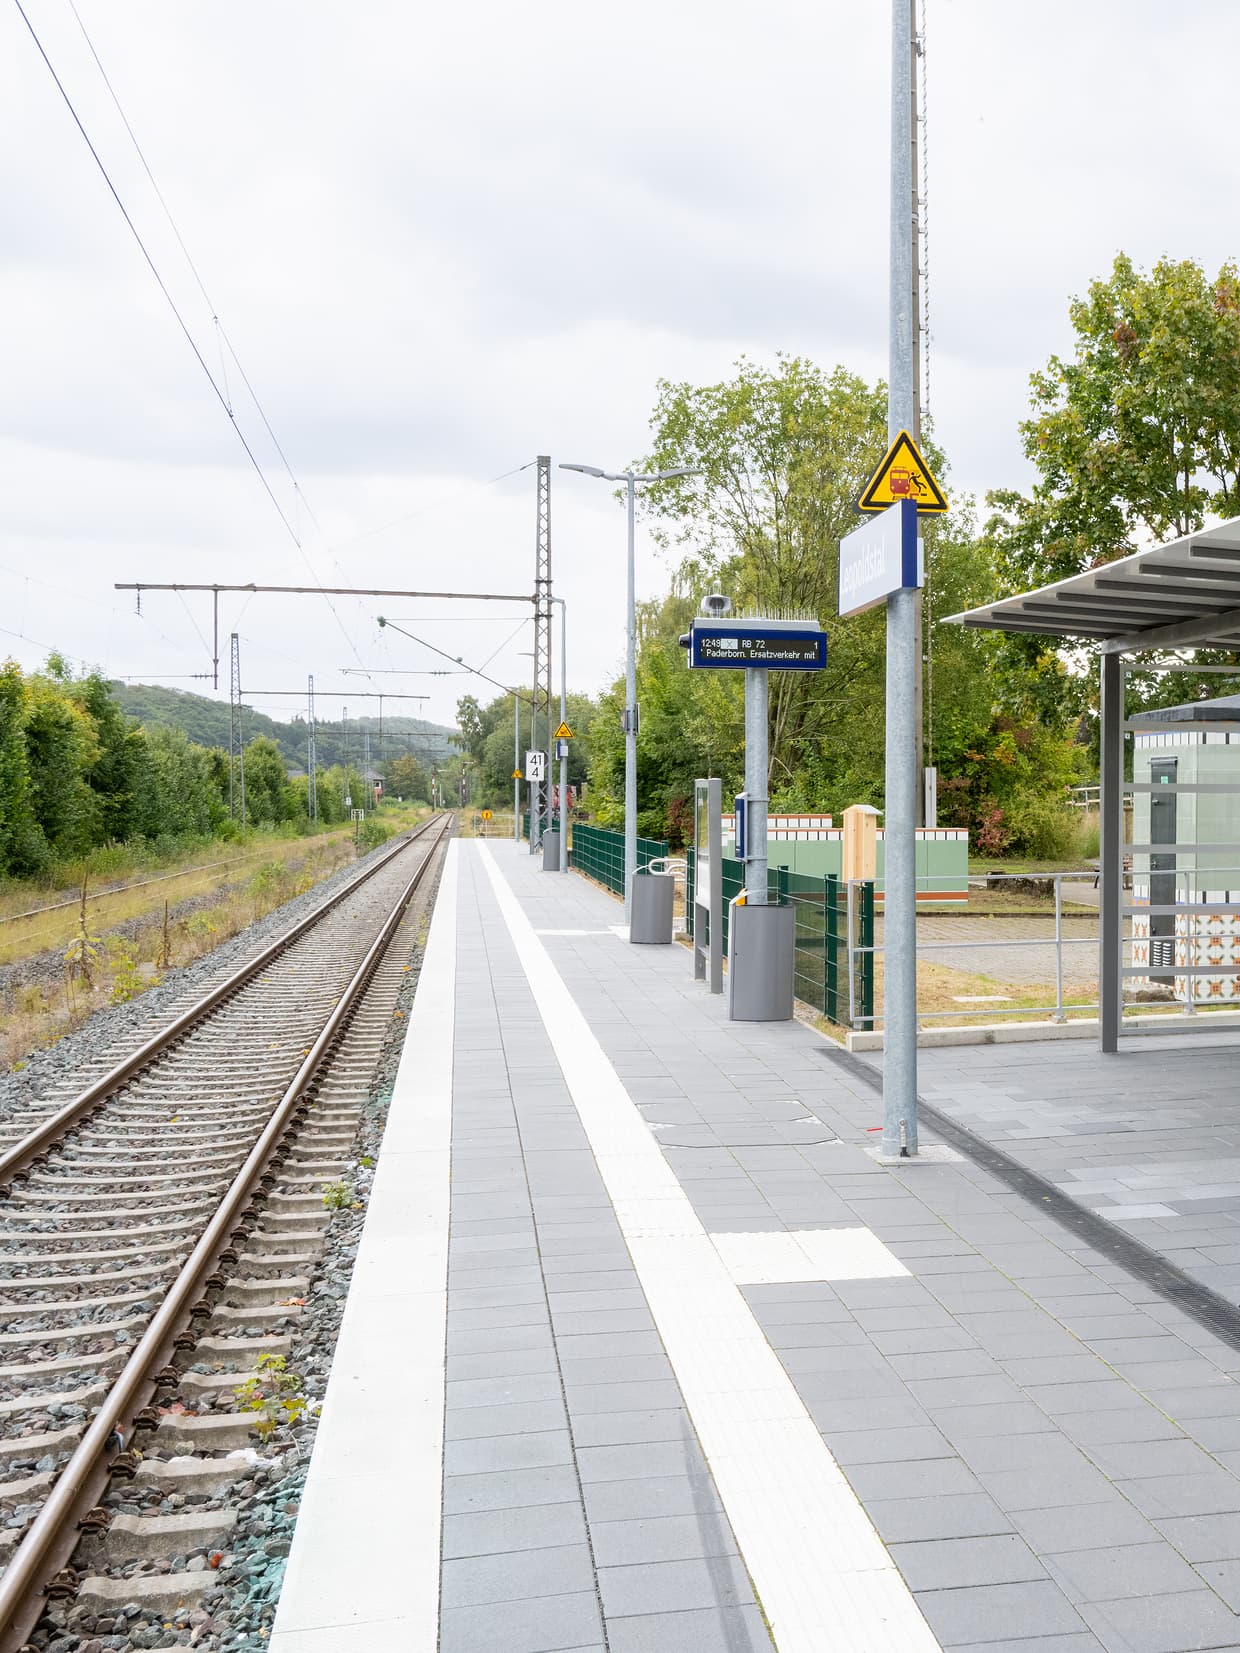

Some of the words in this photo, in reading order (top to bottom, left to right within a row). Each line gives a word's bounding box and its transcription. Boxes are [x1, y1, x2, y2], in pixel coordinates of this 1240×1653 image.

[840, 532, 885, 599] Leopoldstal
[742, 640, 752, 648] RB
[755, 640, 765, 649] 72
[813, 641, 818, 650] 1
[750, 650, 800, 659] Ersatzverkehr
[804, 650, 815, 660] mit
[530, 754, 541, 766] 41
[531, 767, 539, 778] 4
